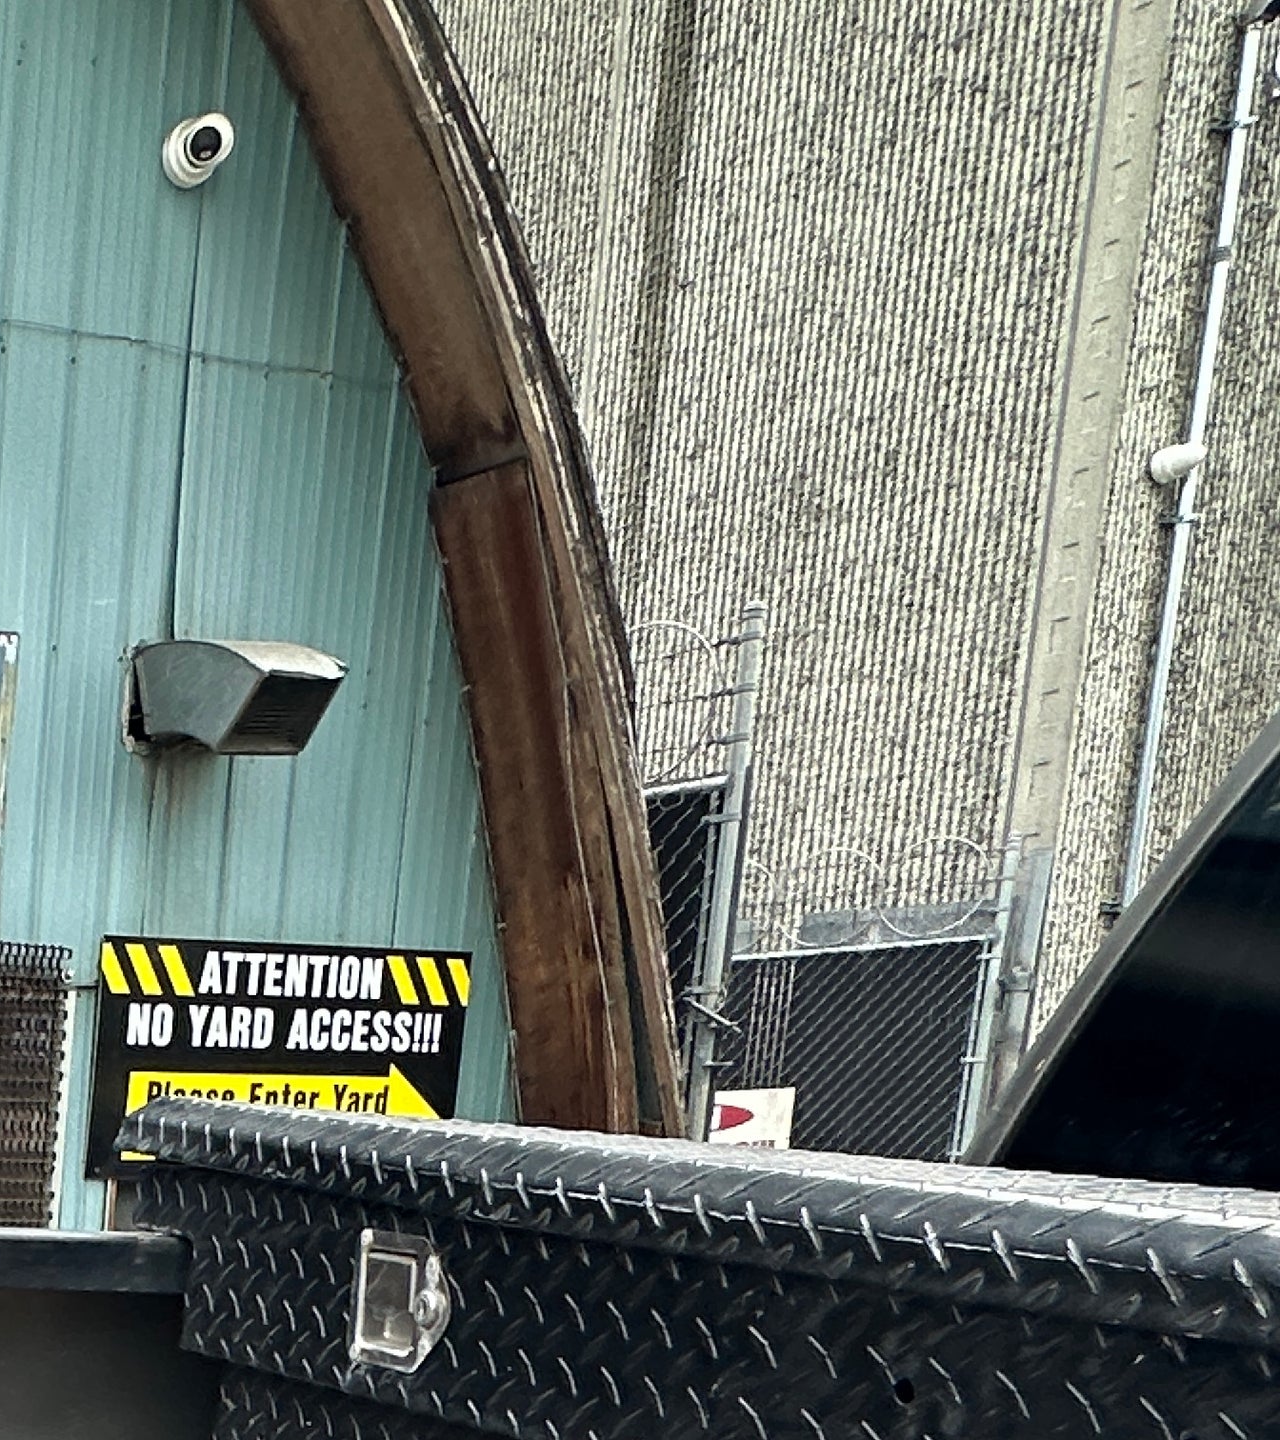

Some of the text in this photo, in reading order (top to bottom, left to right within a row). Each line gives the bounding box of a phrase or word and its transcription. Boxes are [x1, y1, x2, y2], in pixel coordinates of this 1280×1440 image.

[198, 950, 385, 1000] ATTENTION
[127, 1002, 443, 1054] NO YARD ACCESS!!!
[333, 1084, 390, 1115] Yard
